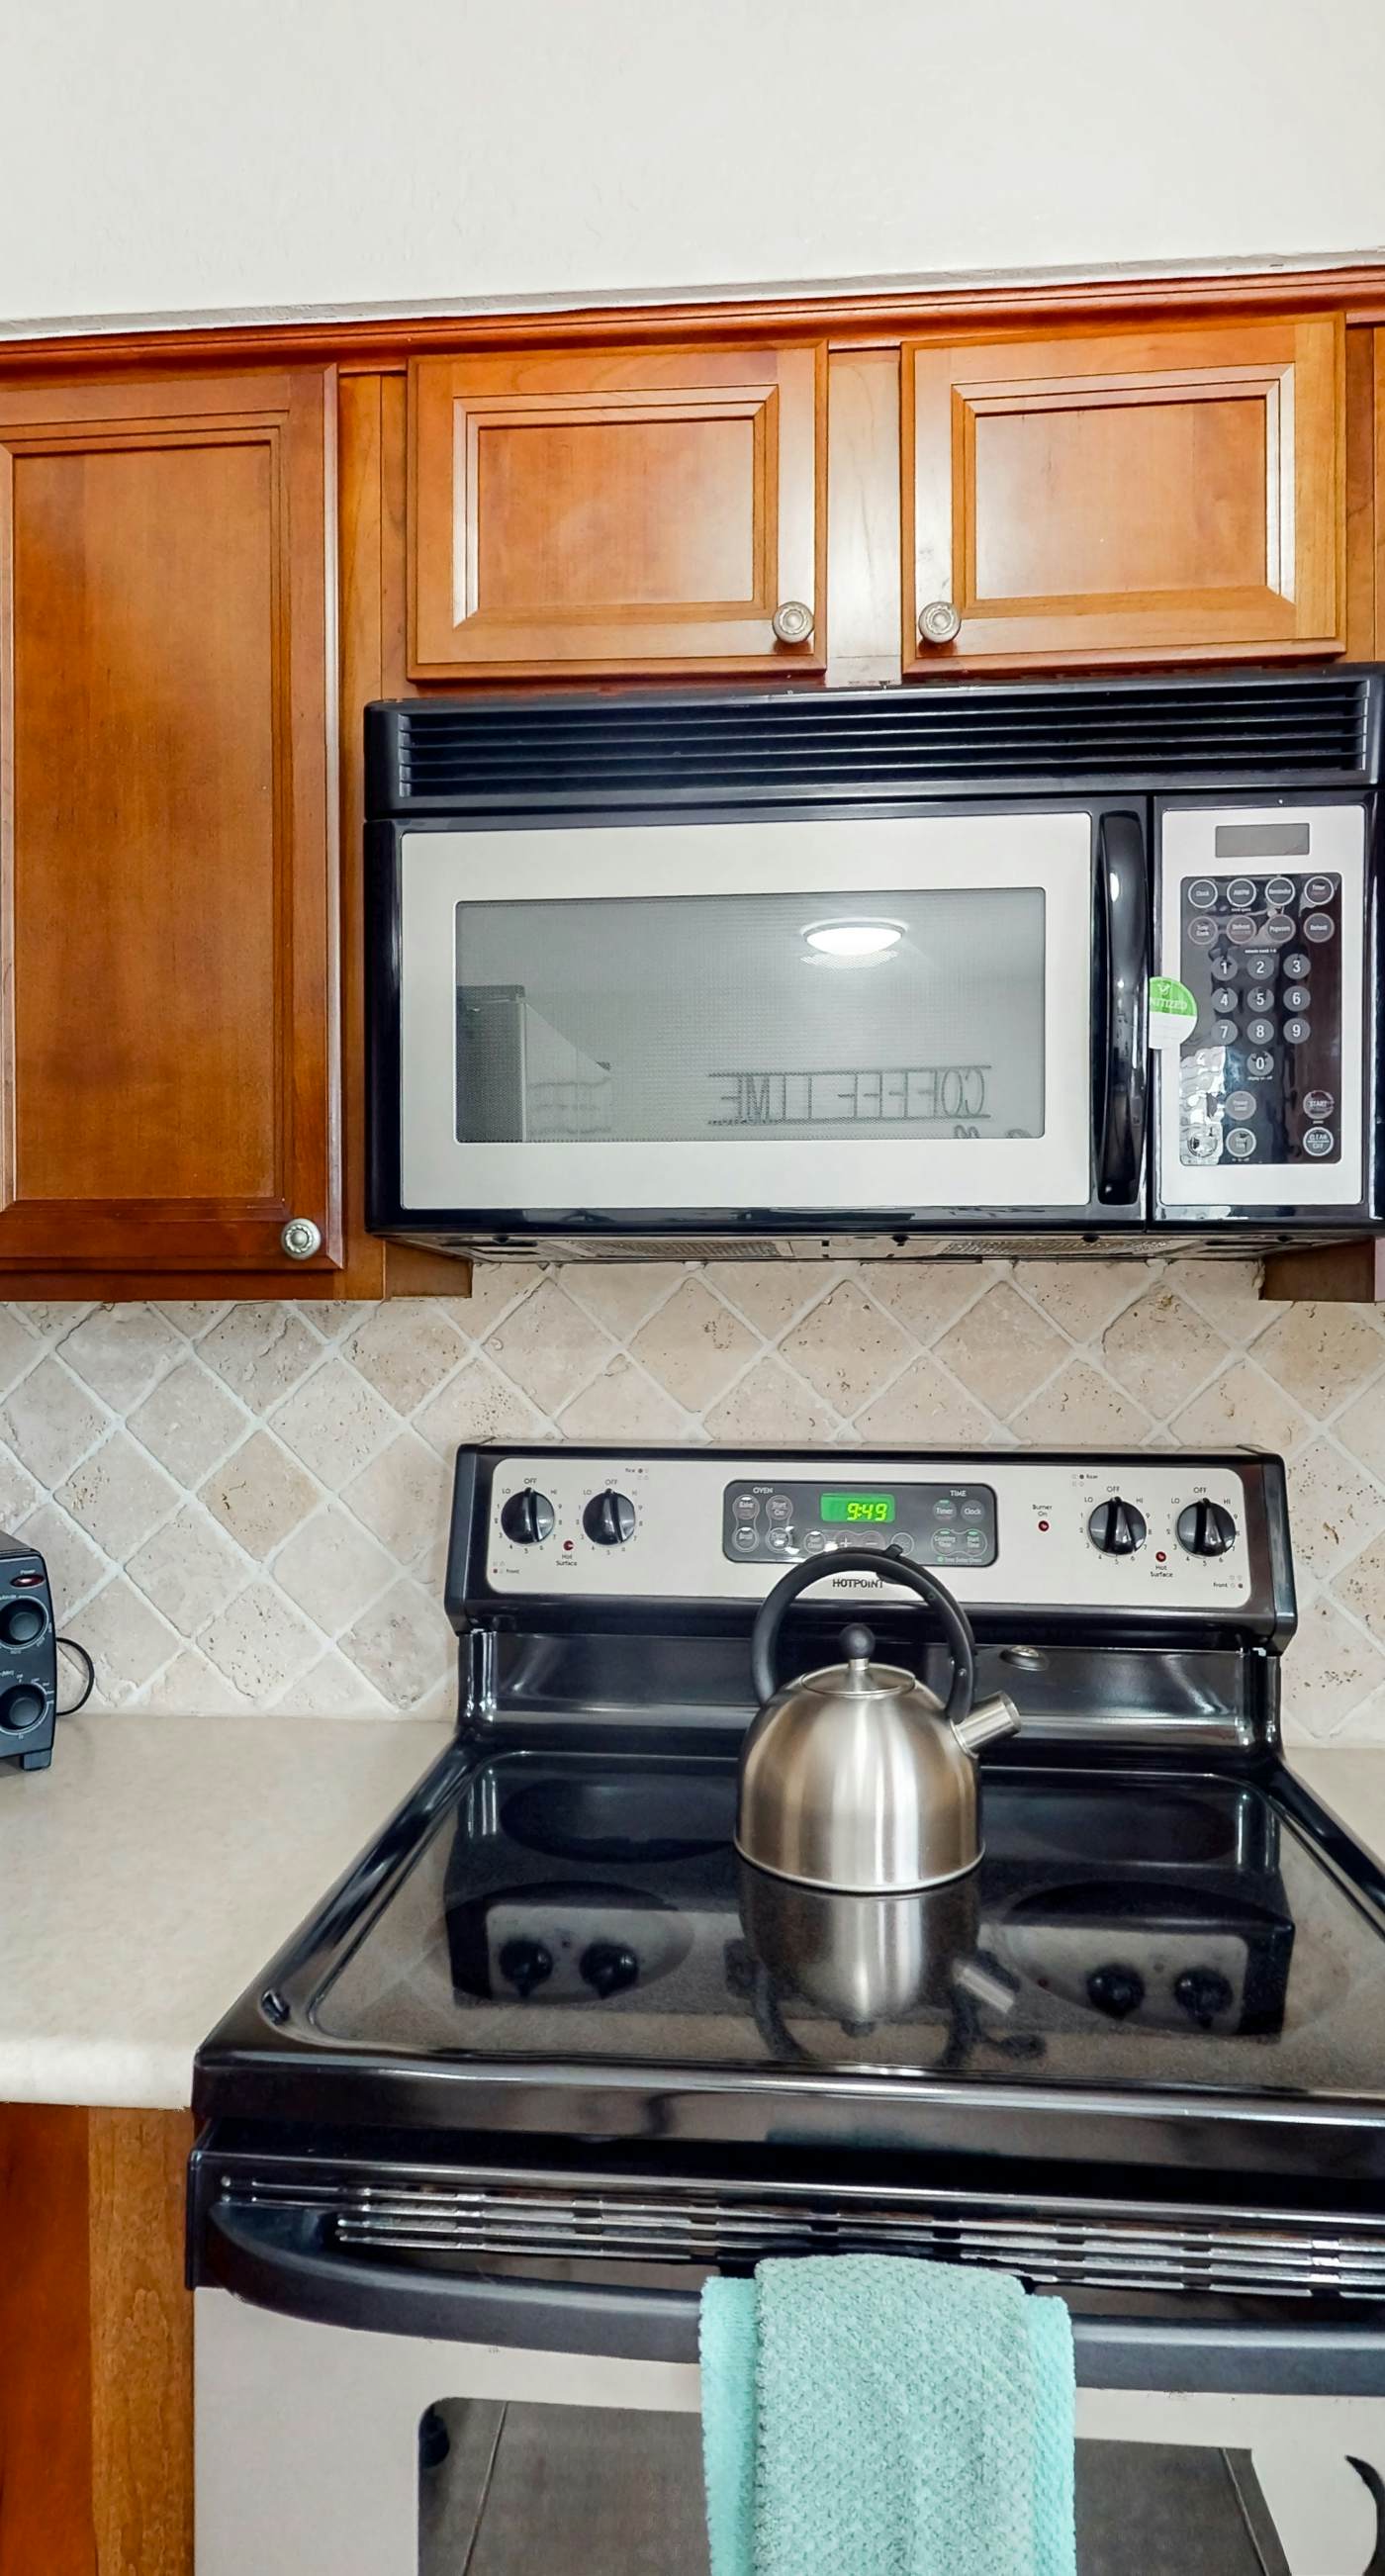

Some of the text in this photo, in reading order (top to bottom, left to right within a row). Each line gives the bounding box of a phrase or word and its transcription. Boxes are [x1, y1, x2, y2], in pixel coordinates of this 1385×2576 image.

[1220, 962, 1228, 974] 1
[1255, 961, 1265, 974] 2
[1292, 960, 1301, 972] 3
[1220, 993, 1228, 1006] 4
[1255, 992, 1265, 1006] 5
[1292, 991, 1301, 1005] 6
[1220, 1025, 1229, 1039] 7
[1255, 1025, 1265, 1038] 8
[1292, 1024, 1301, 1038] 9
[1255, 1057, 1265, 1070] 0
[847, 1503, 887, 1521] 9:49
